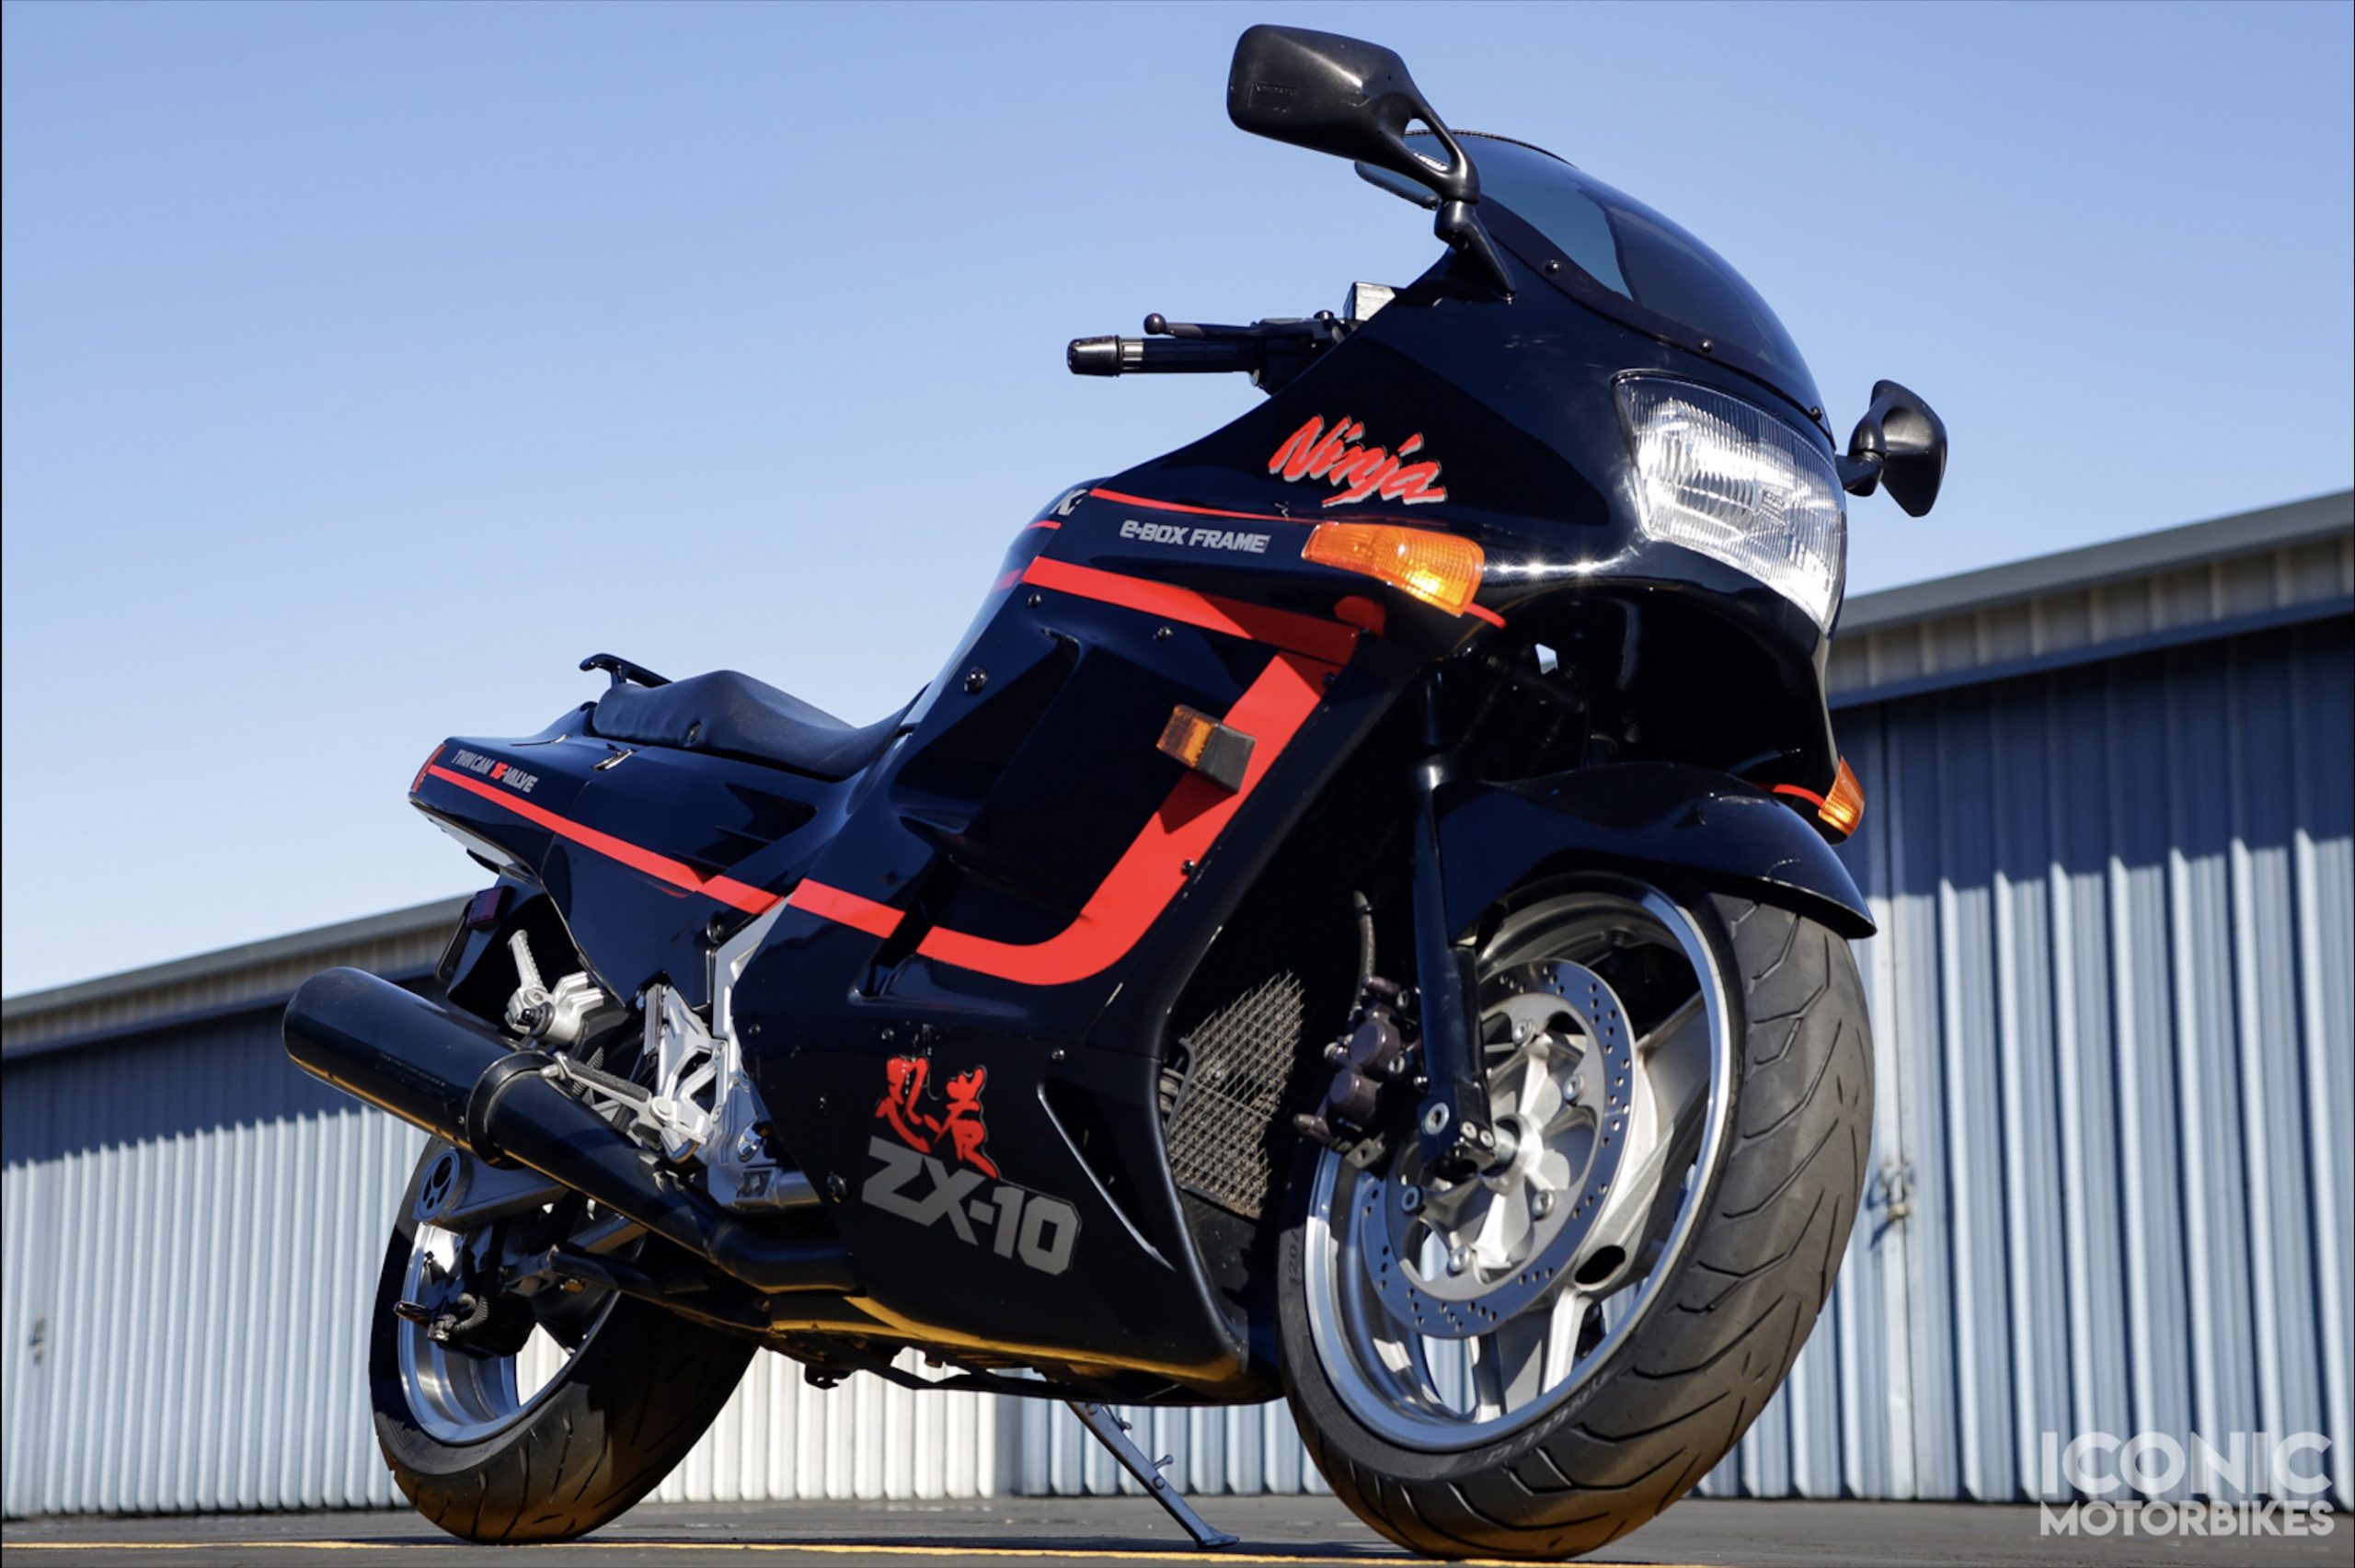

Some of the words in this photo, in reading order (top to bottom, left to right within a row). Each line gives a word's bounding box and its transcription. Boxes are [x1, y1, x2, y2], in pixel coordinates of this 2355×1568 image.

[1268, 414, 1448, 509] Ninja
[1120, 519, 1188, 545] e-BOX
[1189, 528, 1271, 554] FRAME
[469, 755, 496, 775] CAM
[861, 1135, 1082, 1276] ZX-10
